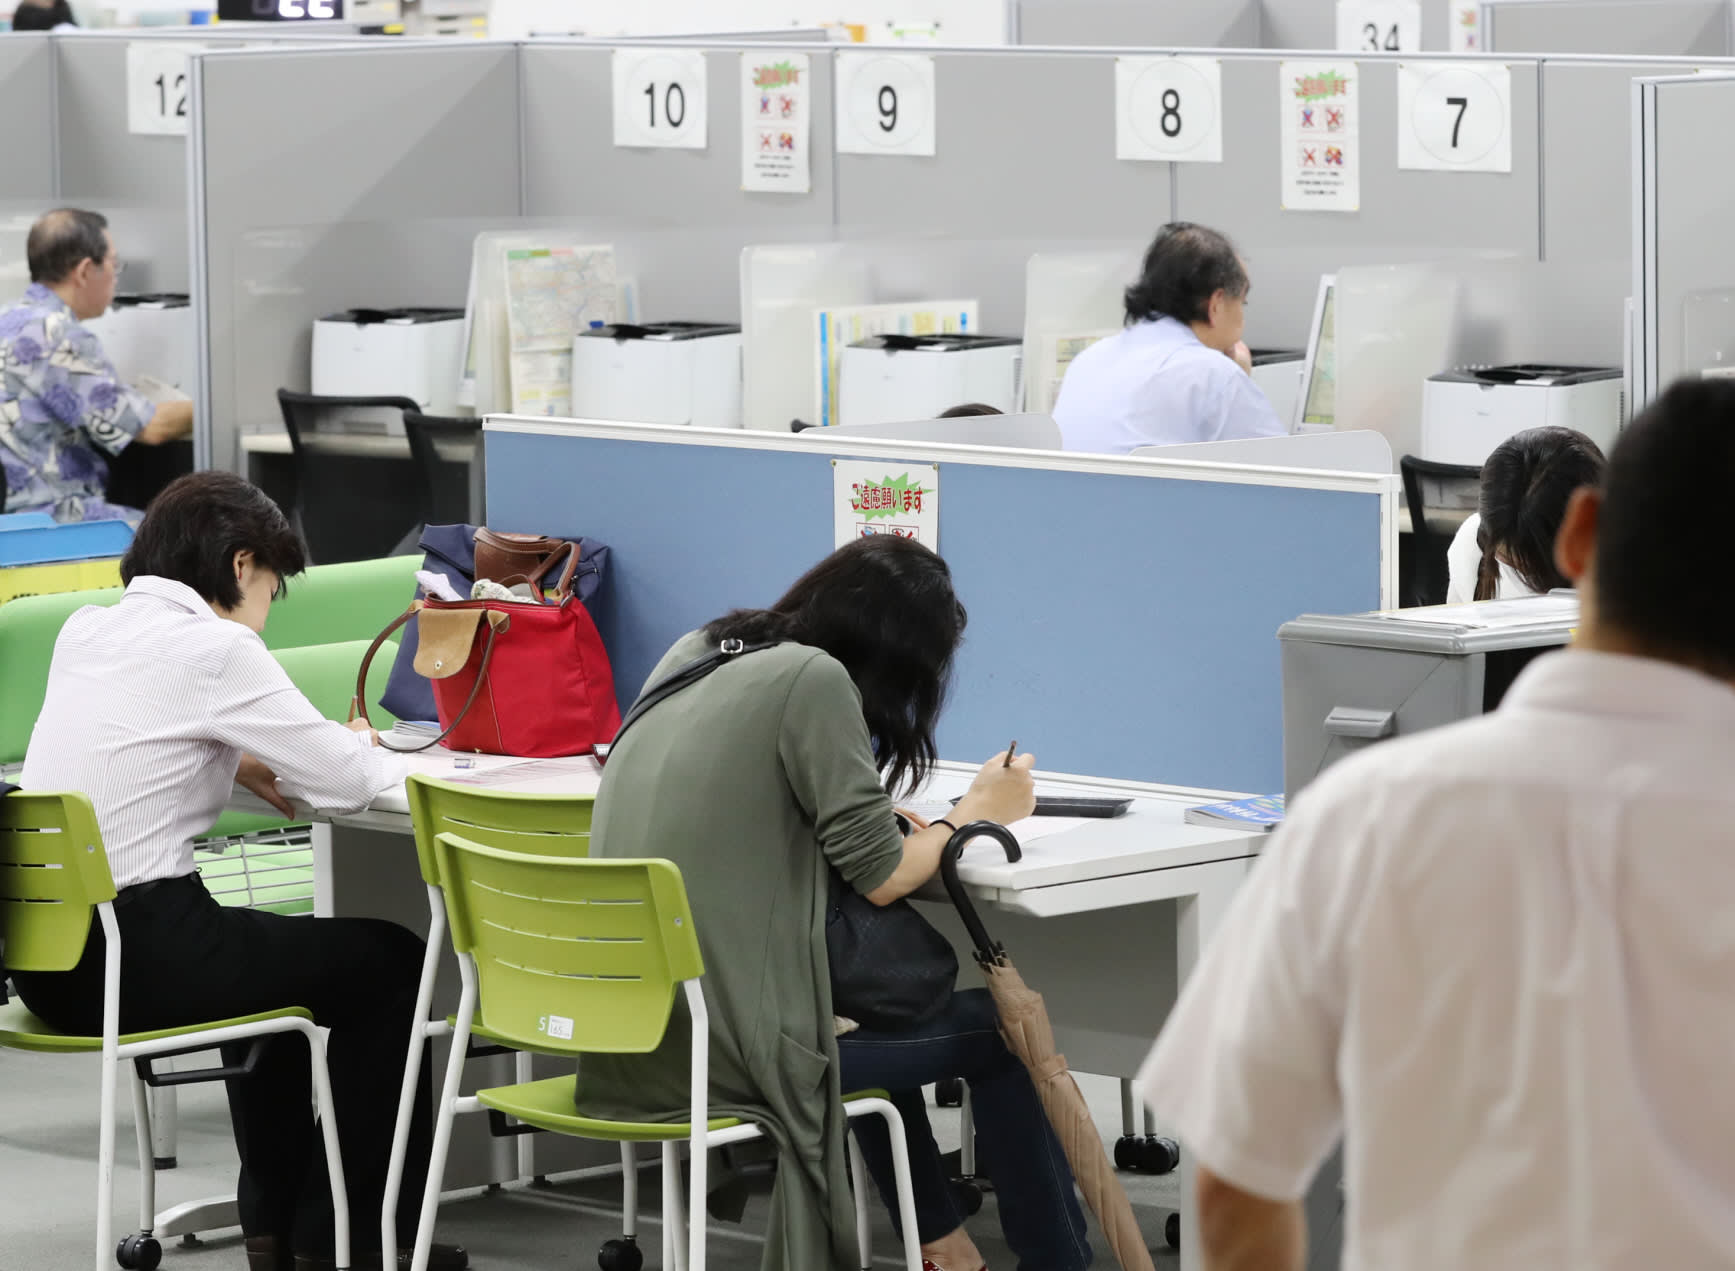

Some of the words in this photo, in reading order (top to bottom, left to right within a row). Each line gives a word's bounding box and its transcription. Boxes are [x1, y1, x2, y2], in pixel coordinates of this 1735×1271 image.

[1362, 23, 1400, 51] 34
[156, 74, 187, 116] 12
[644, 82, 685, 128] 10
[878, 85, 898, 132] 9
[1160, 88, 1182, 138] 8
[1446, 97, 1468, 148] 7
[851, 483, 923, 514] ご遠慮願います
